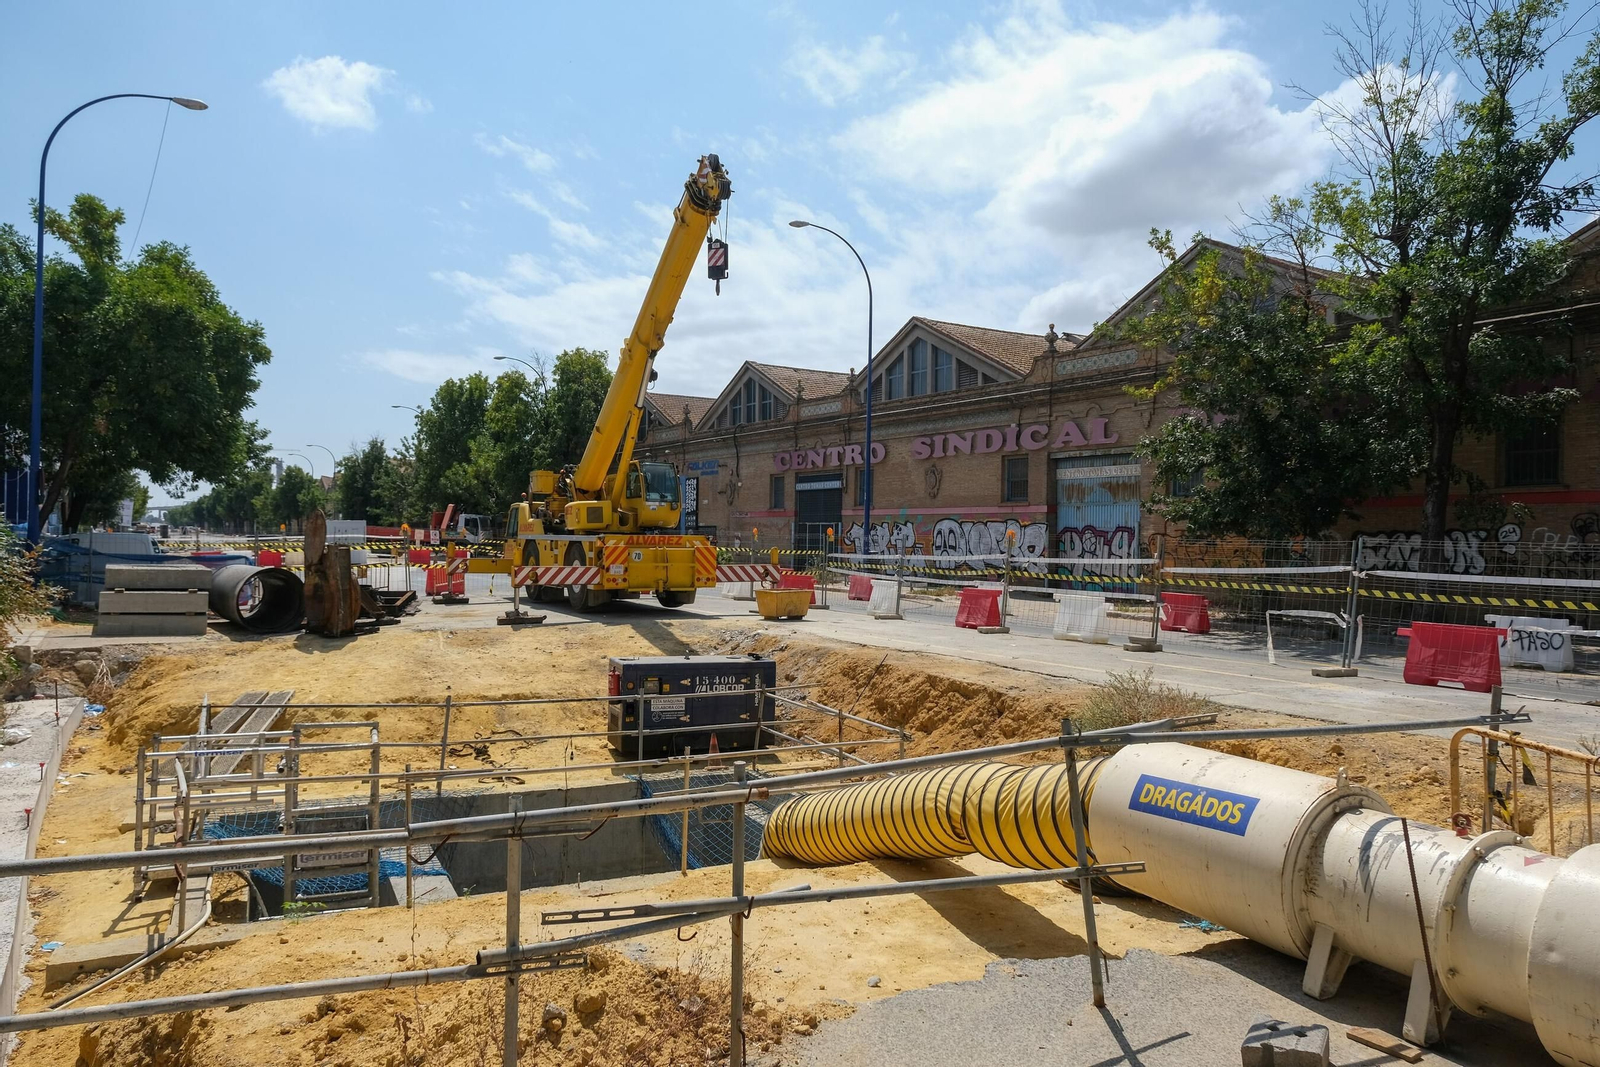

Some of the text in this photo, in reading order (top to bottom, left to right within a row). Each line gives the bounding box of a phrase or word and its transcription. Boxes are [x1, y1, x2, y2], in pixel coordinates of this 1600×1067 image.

[774, 442, 886, 472] CENTRO
[1500, 526, 1518, 540] 24
[625, 535, 684, 546] ALVAREZ
[633, 552, 642, 560] 70
[1139, 783, 1246, 825] DRAGADOS
[300, 850, 366, 864] termiser
